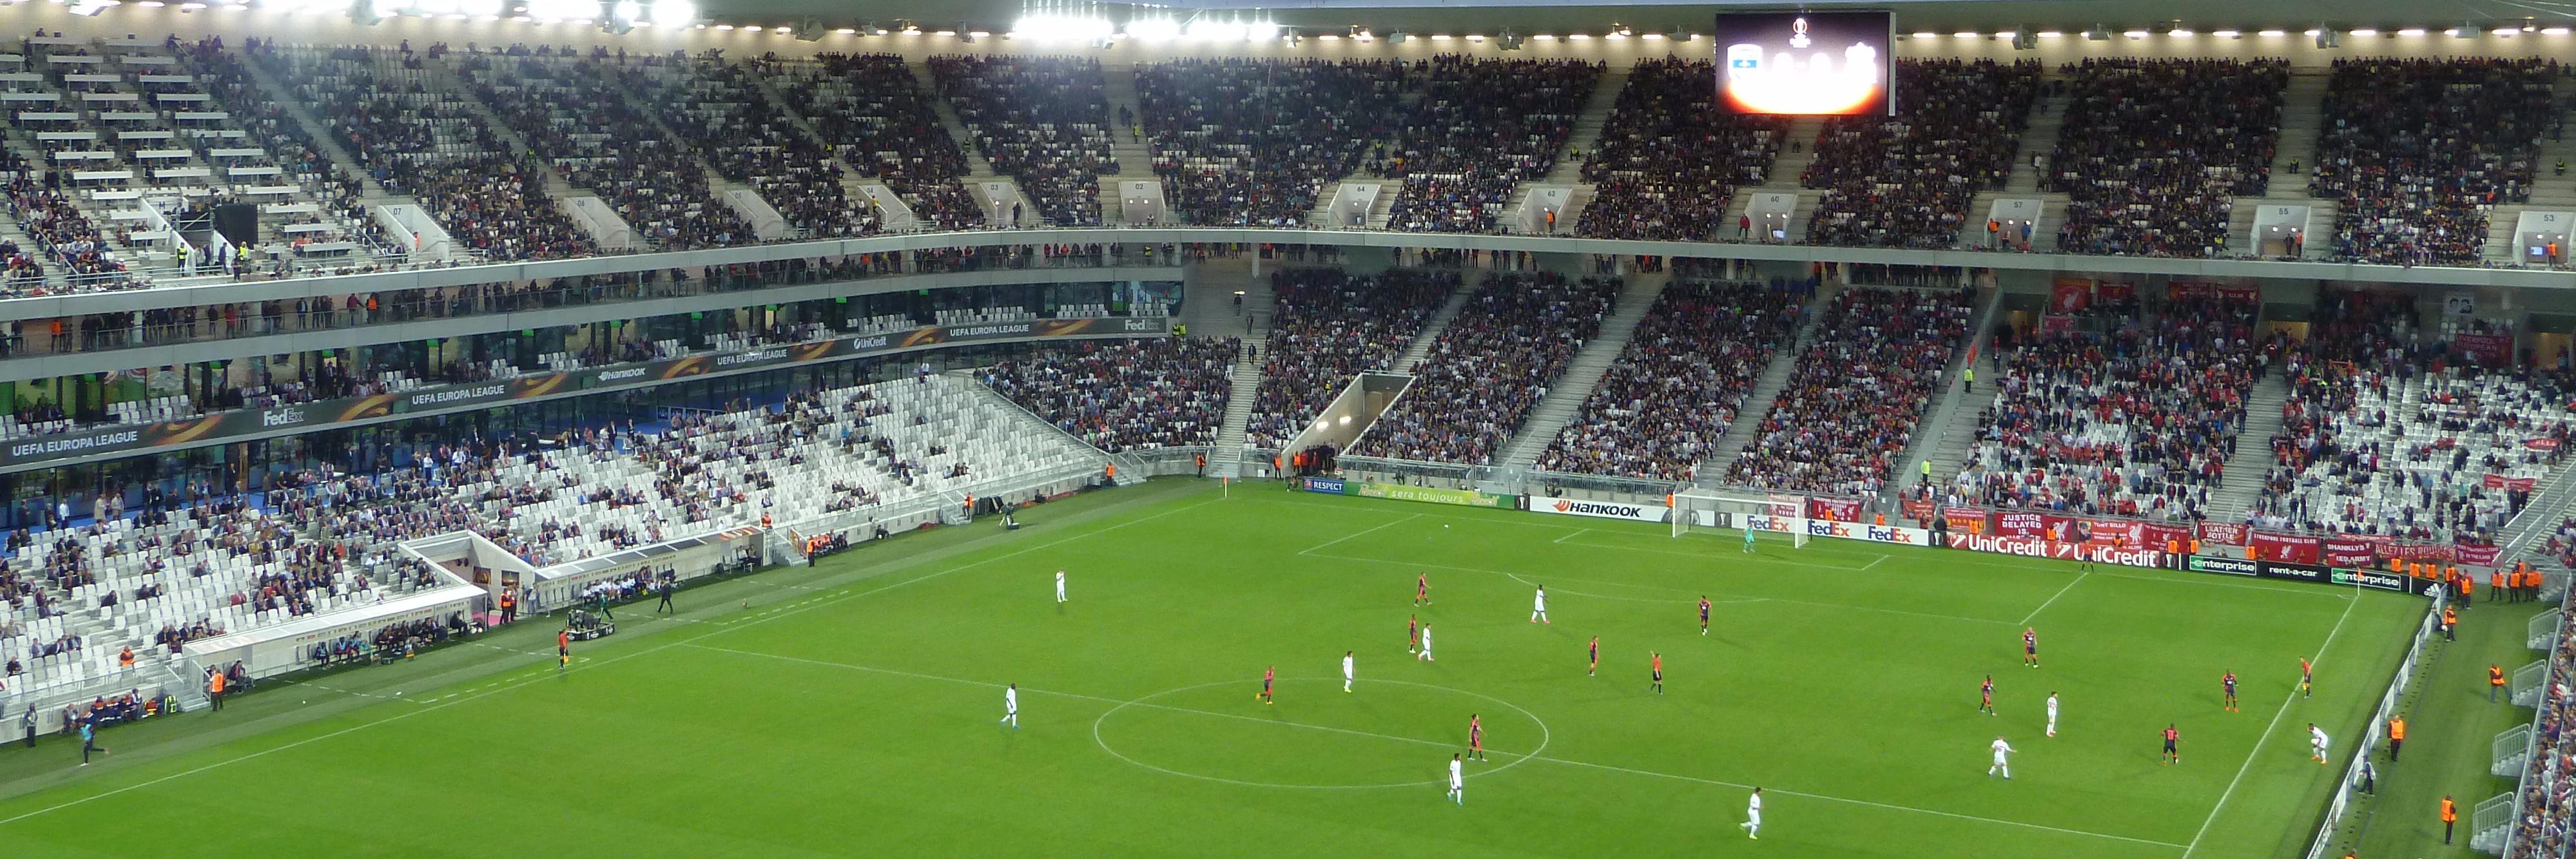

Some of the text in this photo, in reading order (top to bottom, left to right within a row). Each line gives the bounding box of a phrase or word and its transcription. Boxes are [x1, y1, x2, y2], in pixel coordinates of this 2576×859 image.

[950, 325, 1029, 336] UEFA EUROPA LEAGUE
[1125, 319, 1159, 331] FedEx
[860, 336, 887, 348] UniCredit
[717, 349, 787, 365] UEFA EUROPA LEAGUE
[412, 385, 505, 405] UEFA EUROPA LEAGUE
[264, 409, 304, 426] FedEx
[13, 431, 138, 457] UEFA EUROPA LEAGUE
[1313, 481, 1343, 491] RESPECT
[1391, 488, 1414, 499] sera
[1419, 489, 1463, 503] toujours
[1747, 514, 1789, 532] FedEx
[1807, 519, 1850, 537] FedEx
[2205, 525, 2238, 534] LEATHER
[1868, 525, 1912, 543] FedEx
[2207, 532, 2234, 541] BOTTLE
[2254, 533, 2278, 541] LIVERPOOL
[1968, 533, 2047, 557] UniCredit
[2375, 543, 2397, 555] ALLEZ
[2195, 558, 2255, 572] enterprise
[2269, 566, 2318, 577] rent-a-car
[2336, 572, 2399, 586] enterprise
